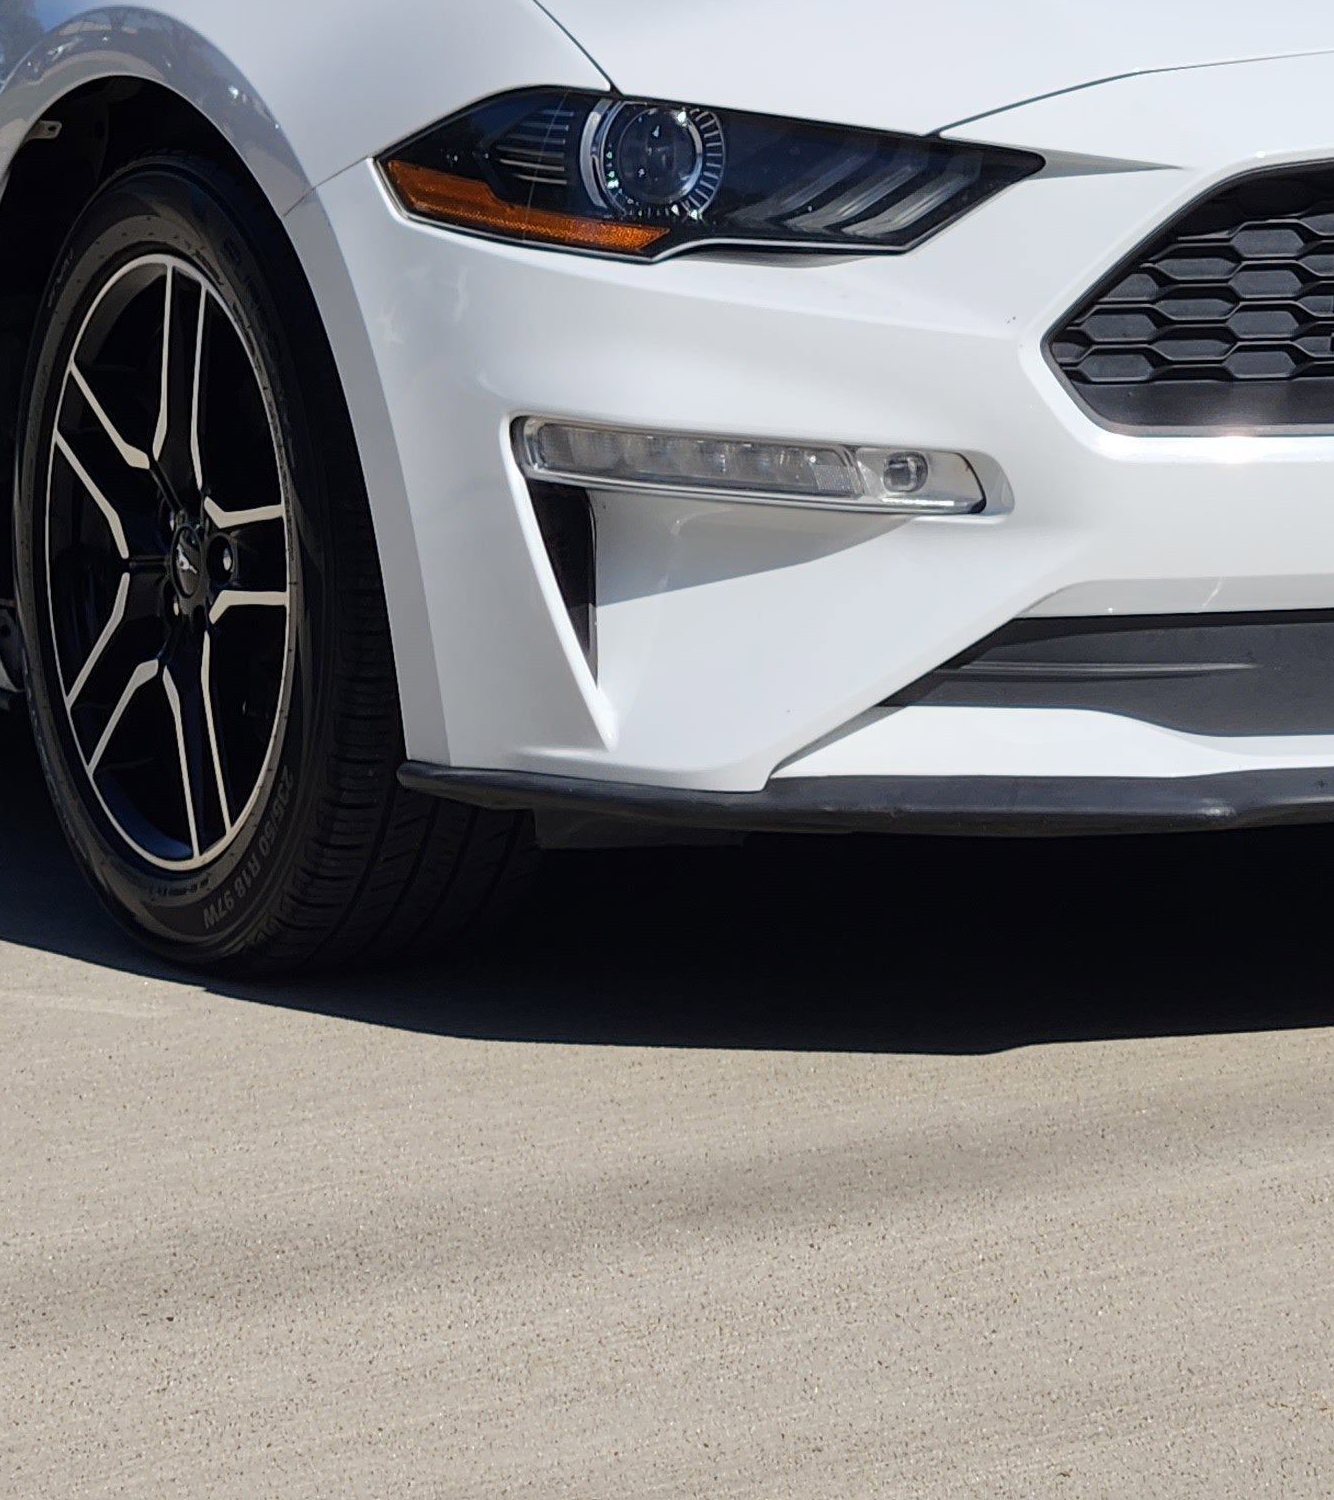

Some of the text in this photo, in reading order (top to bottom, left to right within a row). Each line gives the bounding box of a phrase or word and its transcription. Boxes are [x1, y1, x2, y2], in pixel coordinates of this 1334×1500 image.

[202, 765, 294, 929] 235/50 R18 97W
